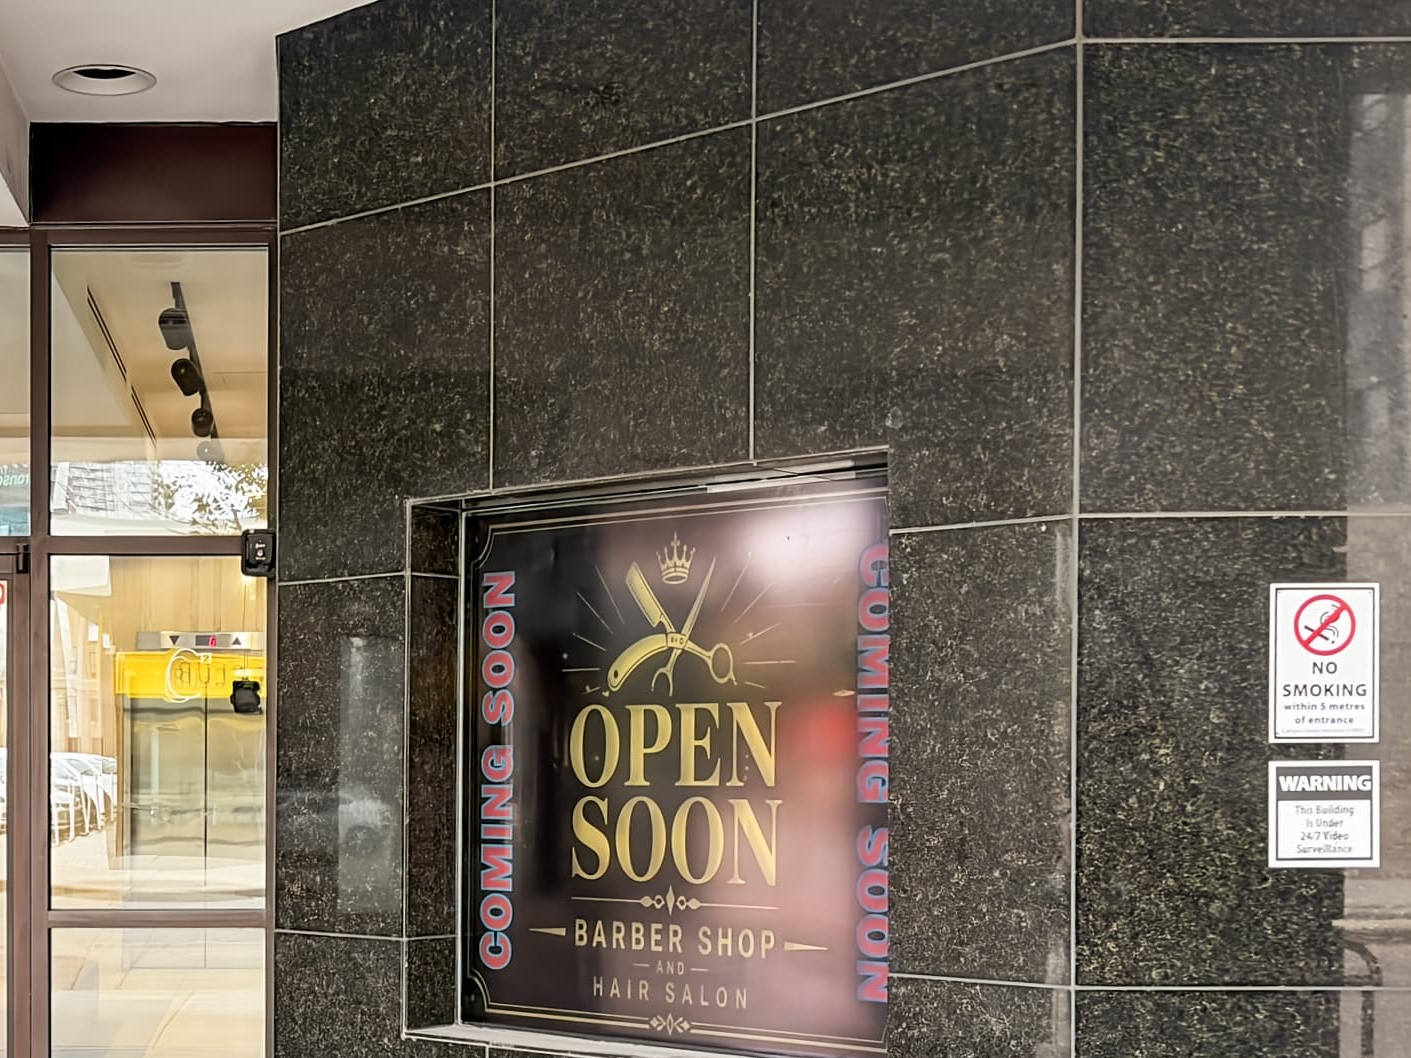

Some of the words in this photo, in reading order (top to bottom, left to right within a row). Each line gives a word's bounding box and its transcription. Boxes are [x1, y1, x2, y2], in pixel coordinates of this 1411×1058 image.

[481, 570, 516, 726] SOON
[856, 542, 890, 804] COMING
[1312, 661, 1338, 675] NO
[1282, 683, 1367, 697] SMOKING
[1284, 702, 1317, 711] within
[1320, 702, 1326, 711] 5
[1329, 703, 1365, 711] metres
[1295, 716, 1306, 724] of
[1308, 716, 1354, 724] entrance
[569, 701, 783, 788] OPEN
[1278, 775, 1372, 792] WARNING
[1295, 805, 1313, 814] This
[1316, 804, 1355, 816] Building
[1316, 818, 1344, 828] Under
[570, 795, 783, 886] SOON
[1323, 831, 1349, 841] Video
[479, 744, 515, 970] COMING
[856, 824, 890, 1004] SOON
[574, 918, 683, 953] BARBER
[698, 926, 775, 960] SHOP
[655, 960, 685, 976] AND
[593, 976, 650, 1001] HAIR
[665, 982, 748, 1009] SALON
